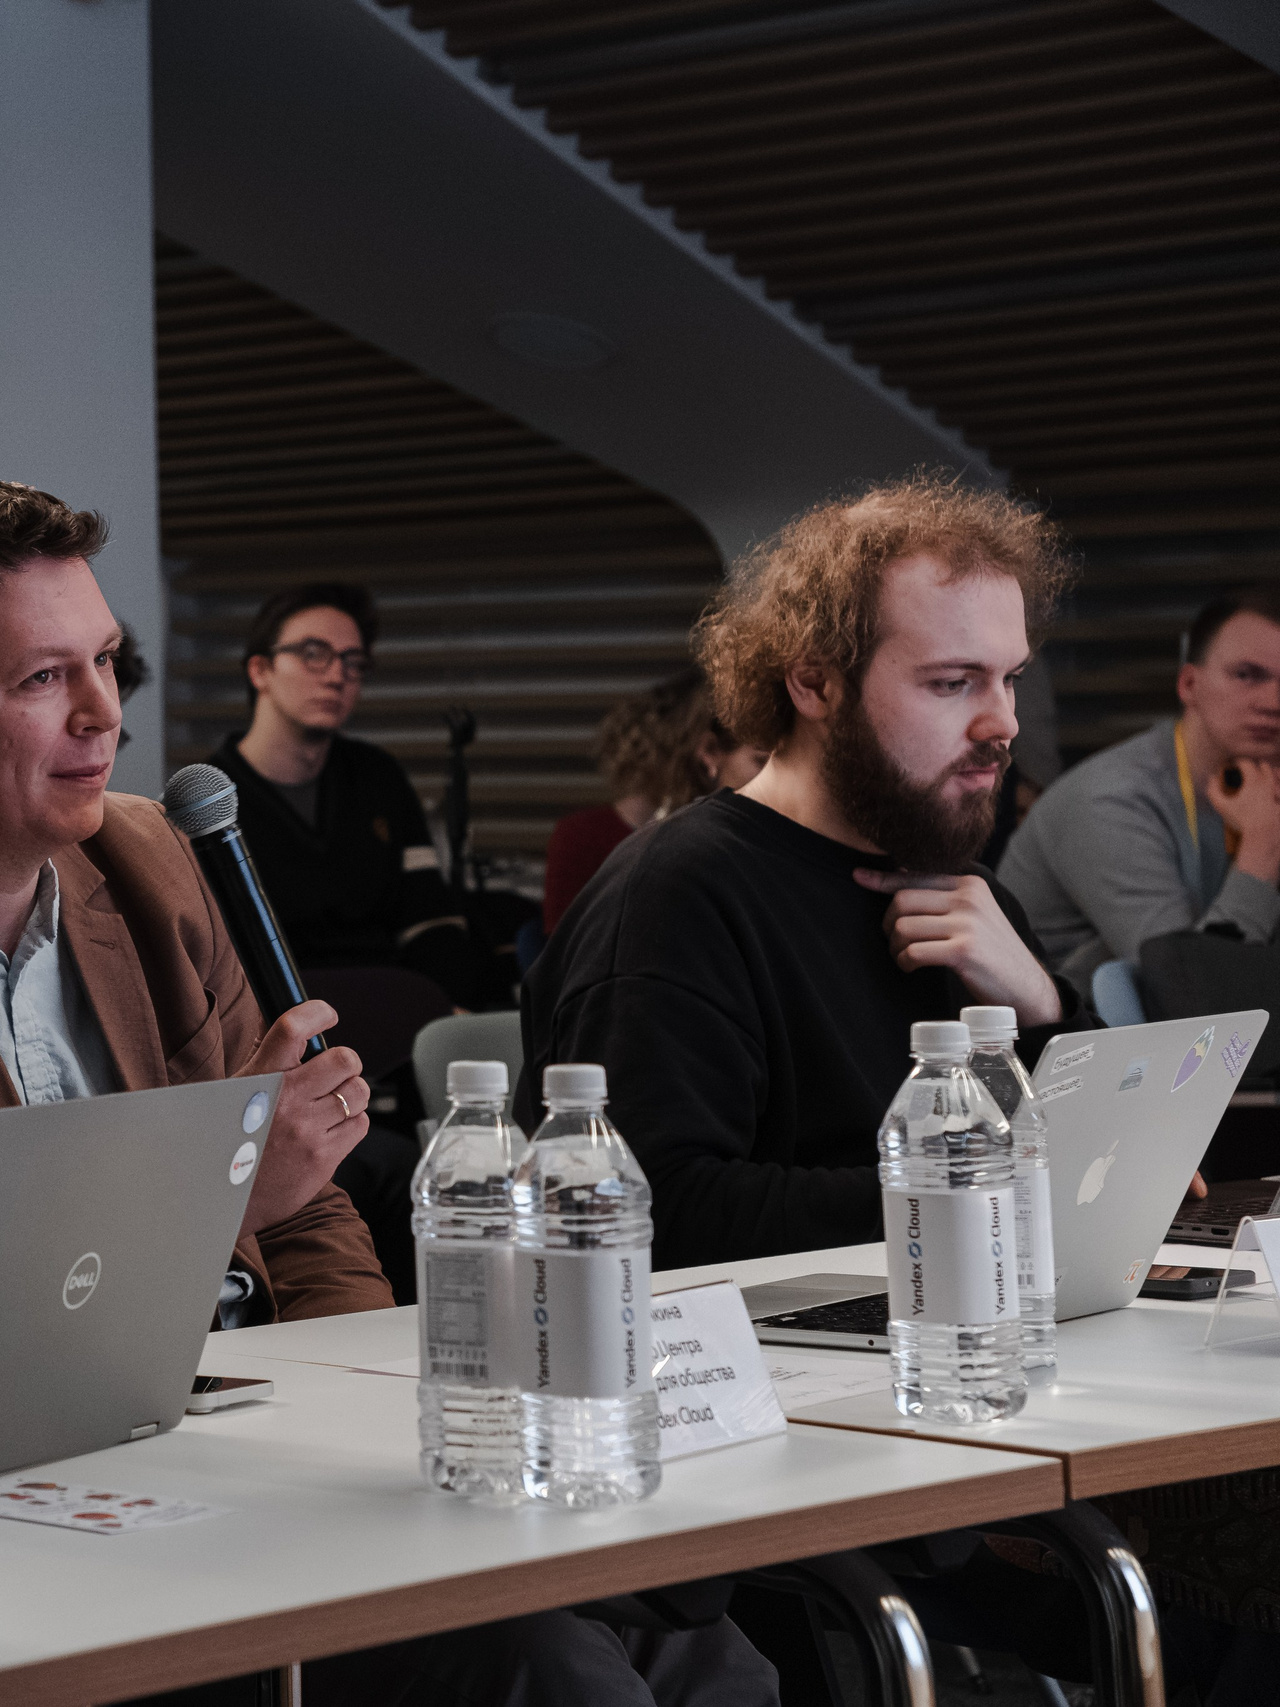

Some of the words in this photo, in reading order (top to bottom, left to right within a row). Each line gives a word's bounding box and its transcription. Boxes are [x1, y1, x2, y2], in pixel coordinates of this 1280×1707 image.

[907, 1198, 921, 1239] Cloud
[990, 1196, 1001, 1237] Cloud
[68, 1272, 95, 1290] DELL
[533, 1259, 547, 1304] Cloud
[620, 1258, 634, 1303] Cloud
[910, 1262, 925, 1316] Yandex
[995, 1261, 1006, 1315] Yandex
[536, 1329, 551, 1388] Yandex
[624, 1329, 637, 1389] Yandex
[655, 1338, 703, 1360] Центра
[655, 1375, 680, 1393] для
[680, 1366, 737, 1387] общества
[655, 1410, 680, 1430] dex
[678, 1403, 714, 1424] Cloud
